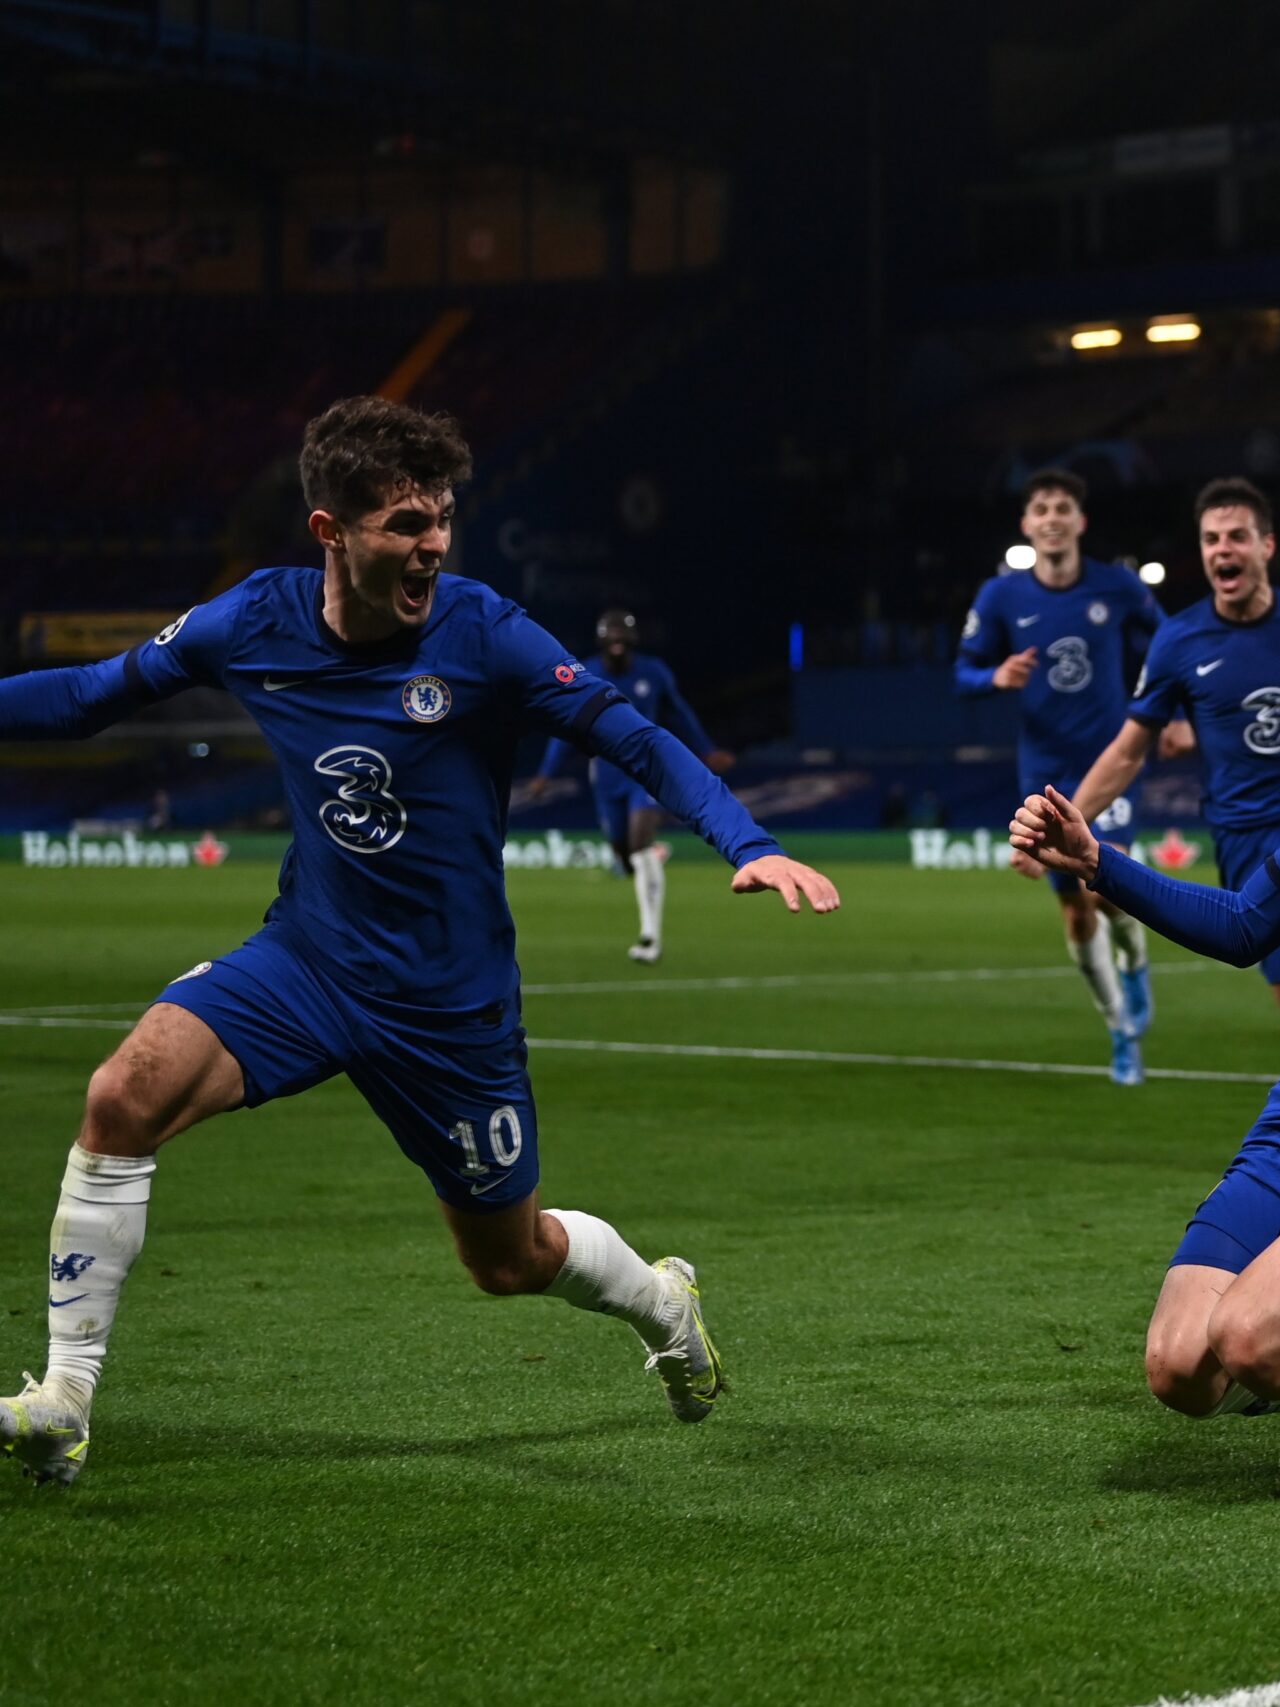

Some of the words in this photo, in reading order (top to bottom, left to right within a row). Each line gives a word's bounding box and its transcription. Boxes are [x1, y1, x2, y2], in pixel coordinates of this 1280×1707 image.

[409, 677, 441, 688] CHELSEA
[1046, 635, 1094, 694] 3
[314, 744, 407, 854] 3
[22, 830, 190, 868] Heineken
[449, 1105, 522, 1176] 10
